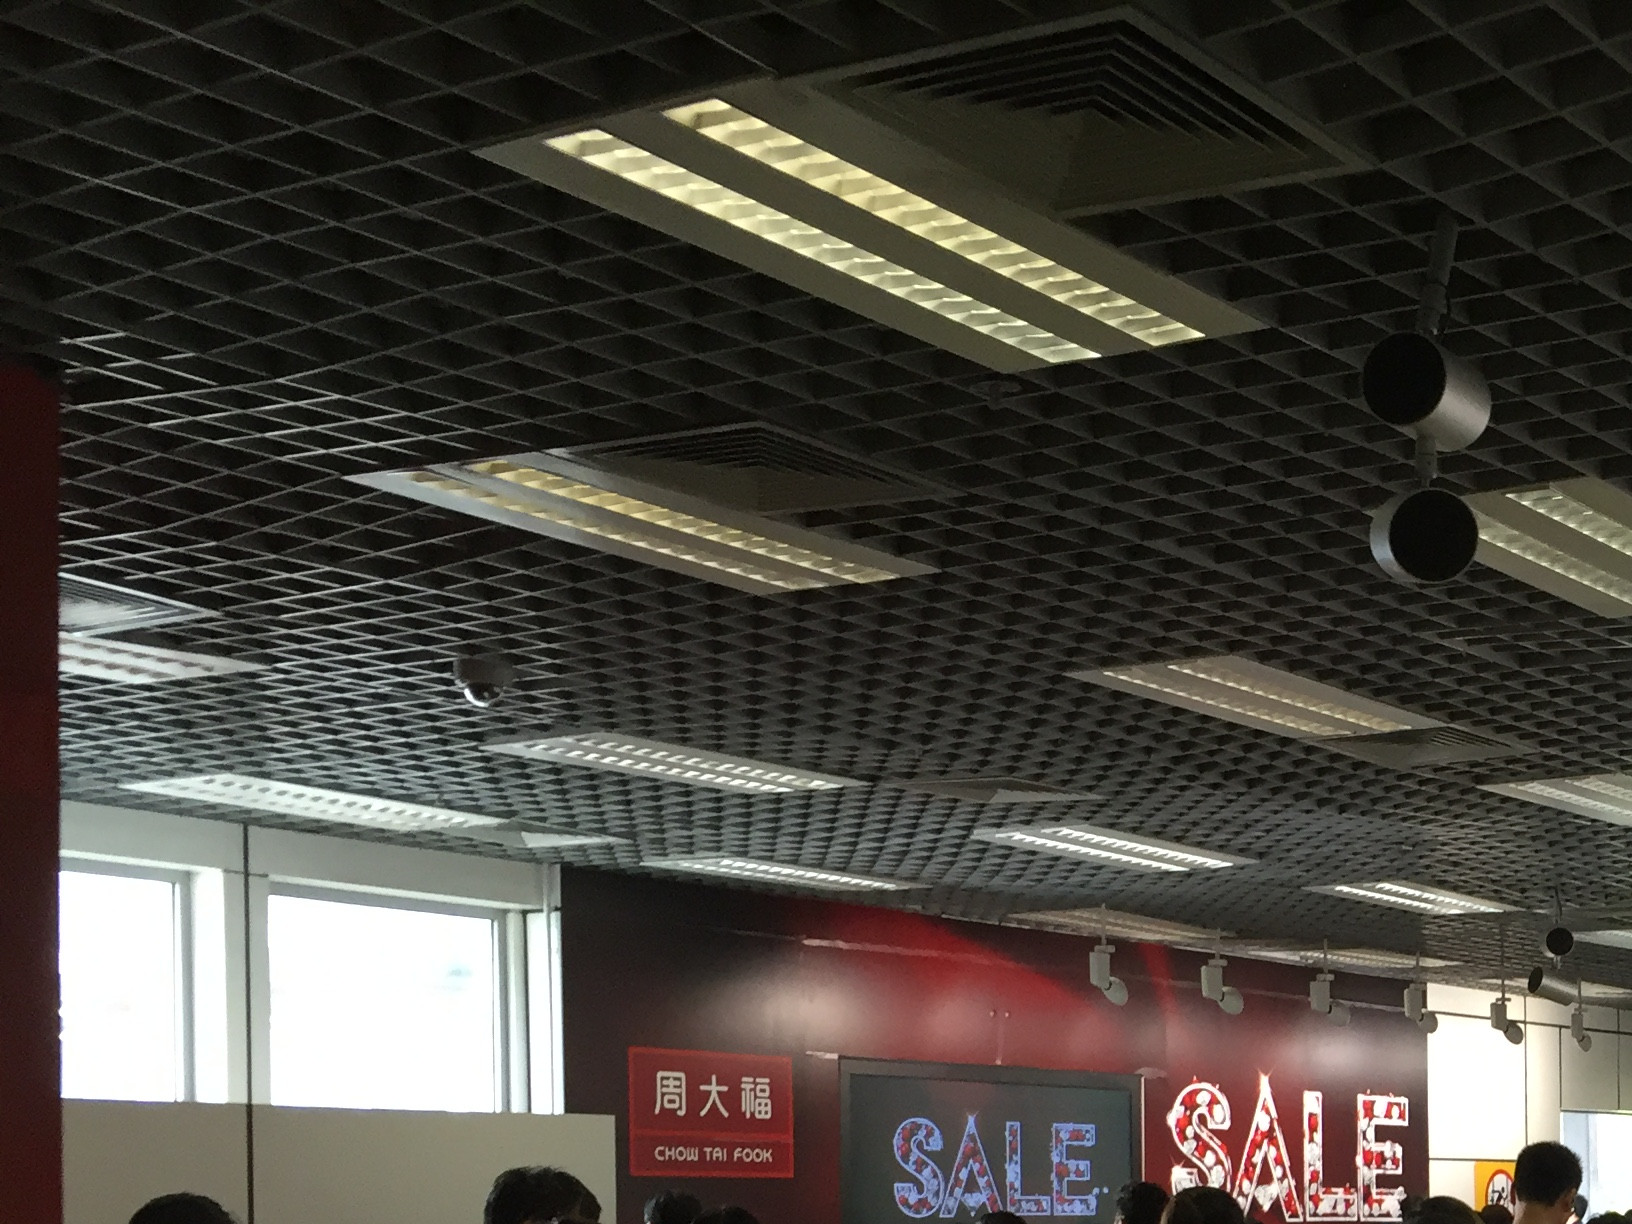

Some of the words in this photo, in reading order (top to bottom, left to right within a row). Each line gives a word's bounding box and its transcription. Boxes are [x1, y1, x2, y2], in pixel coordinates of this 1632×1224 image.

[655, 1070, 772, 1120] 周大福
[654, 1146, 699, 1162] CHOW
[704, 1148, 727, 1162] TAI
[733, 1148, 773, 1163] FOOK
[893, 1112, 1097, 1218] SALE
[1167, 1069, 1409, 1222] SALE
